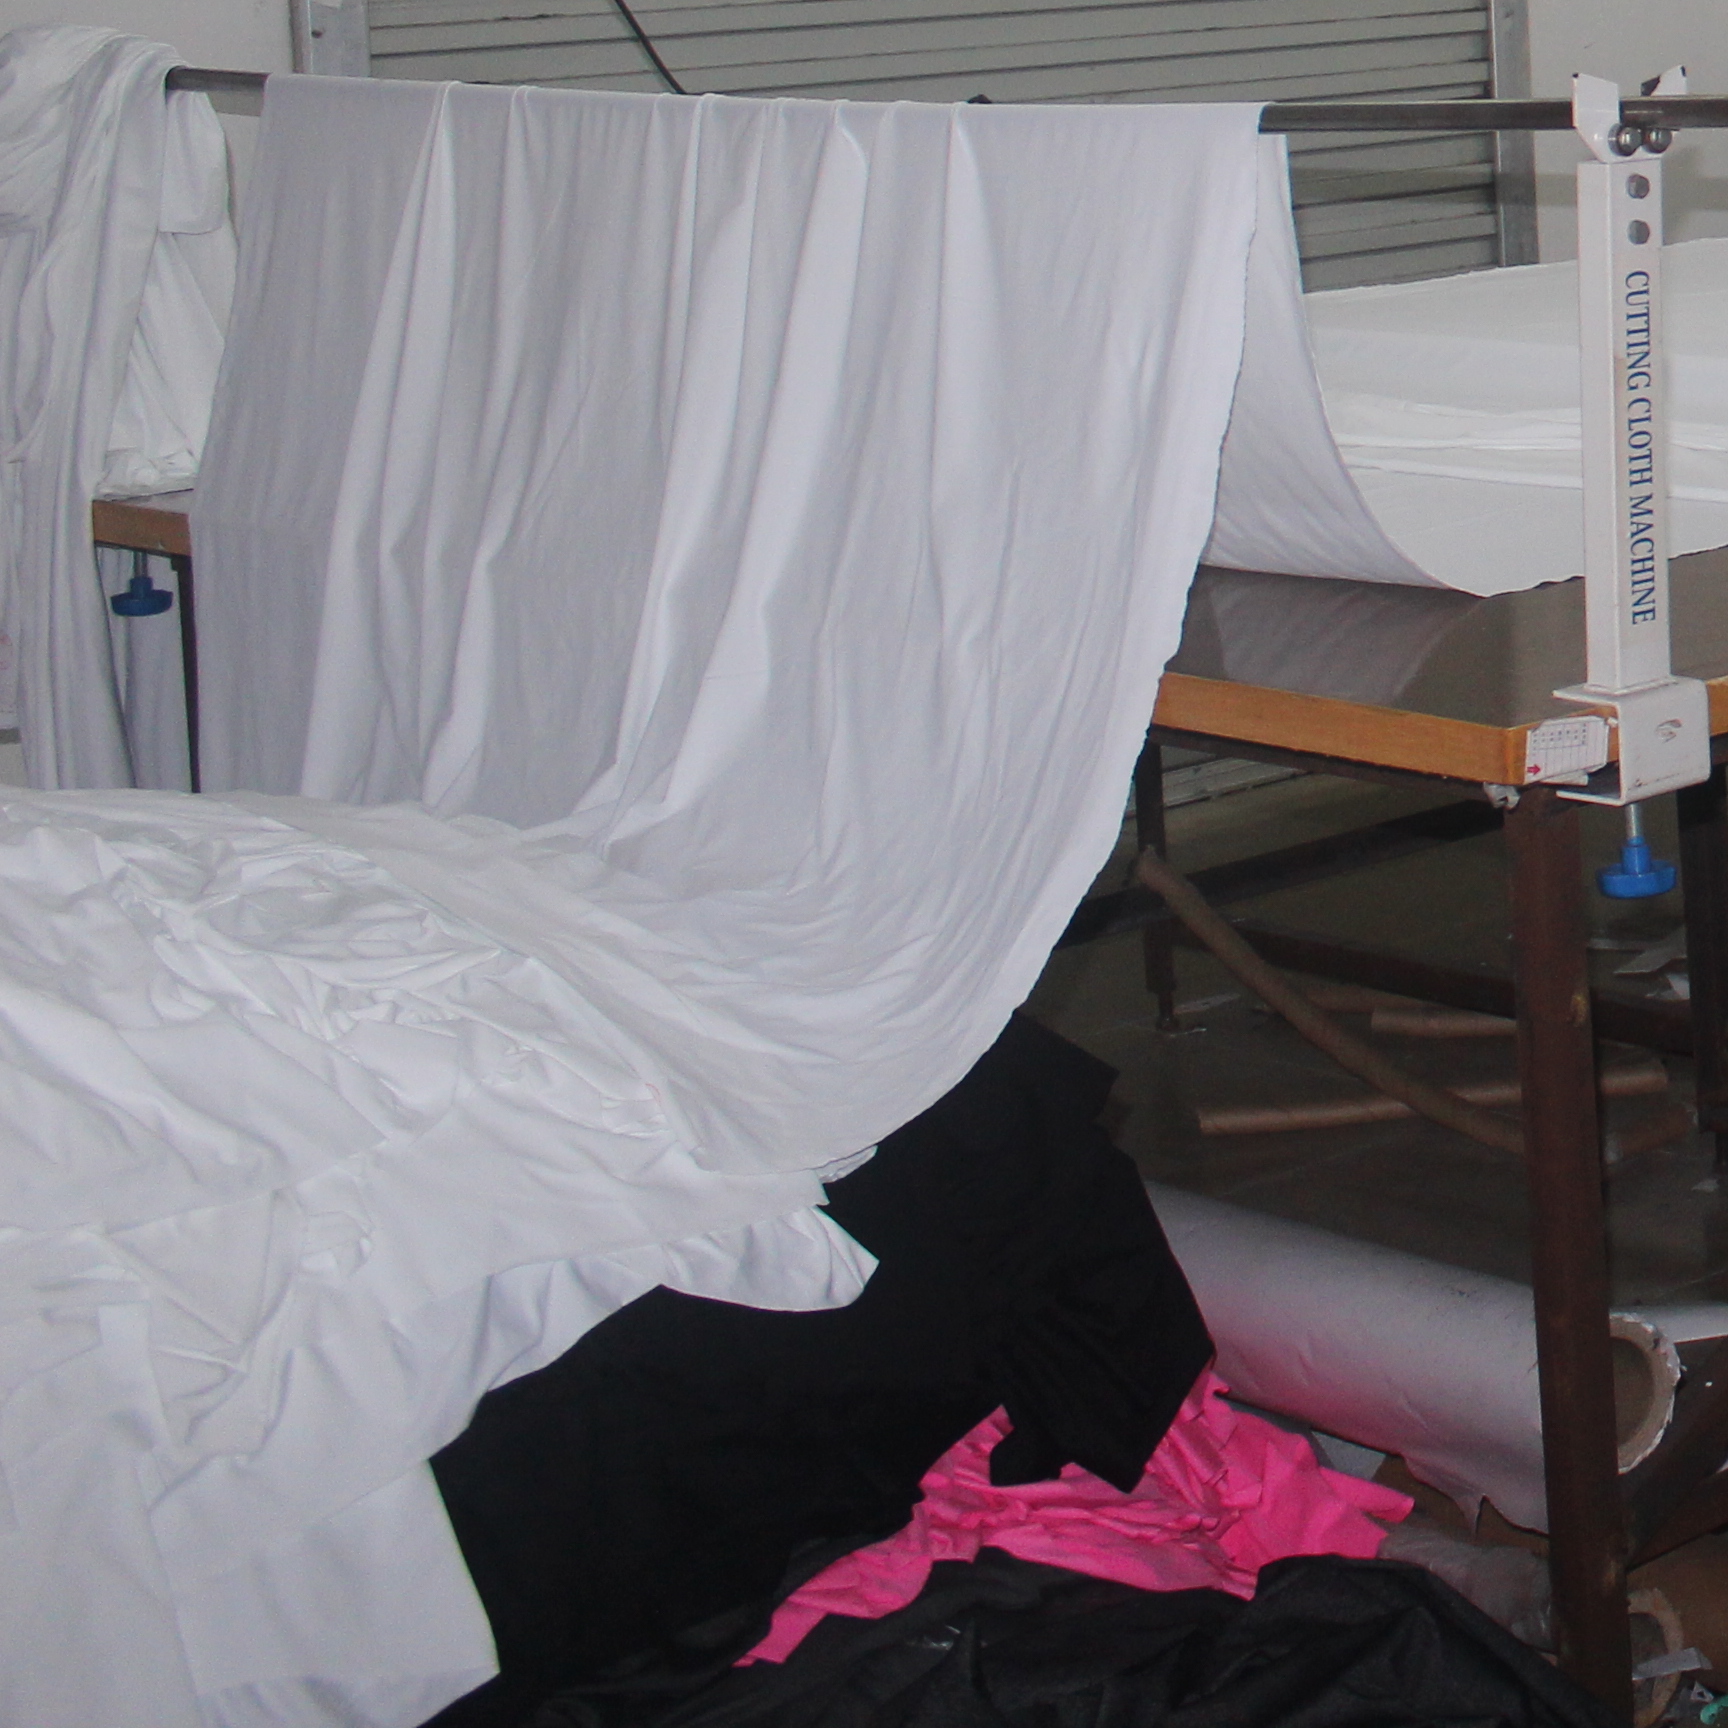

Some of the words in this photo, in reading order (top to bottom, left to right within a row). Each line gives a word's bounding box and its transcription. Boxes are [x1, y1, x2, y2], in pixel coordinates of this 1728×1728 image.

[1624, 270, 1652, 391] CUTTING
[1626, 397, 1654, 487] CLOTH
[1629, 493, 1656, 625] MACHINE
